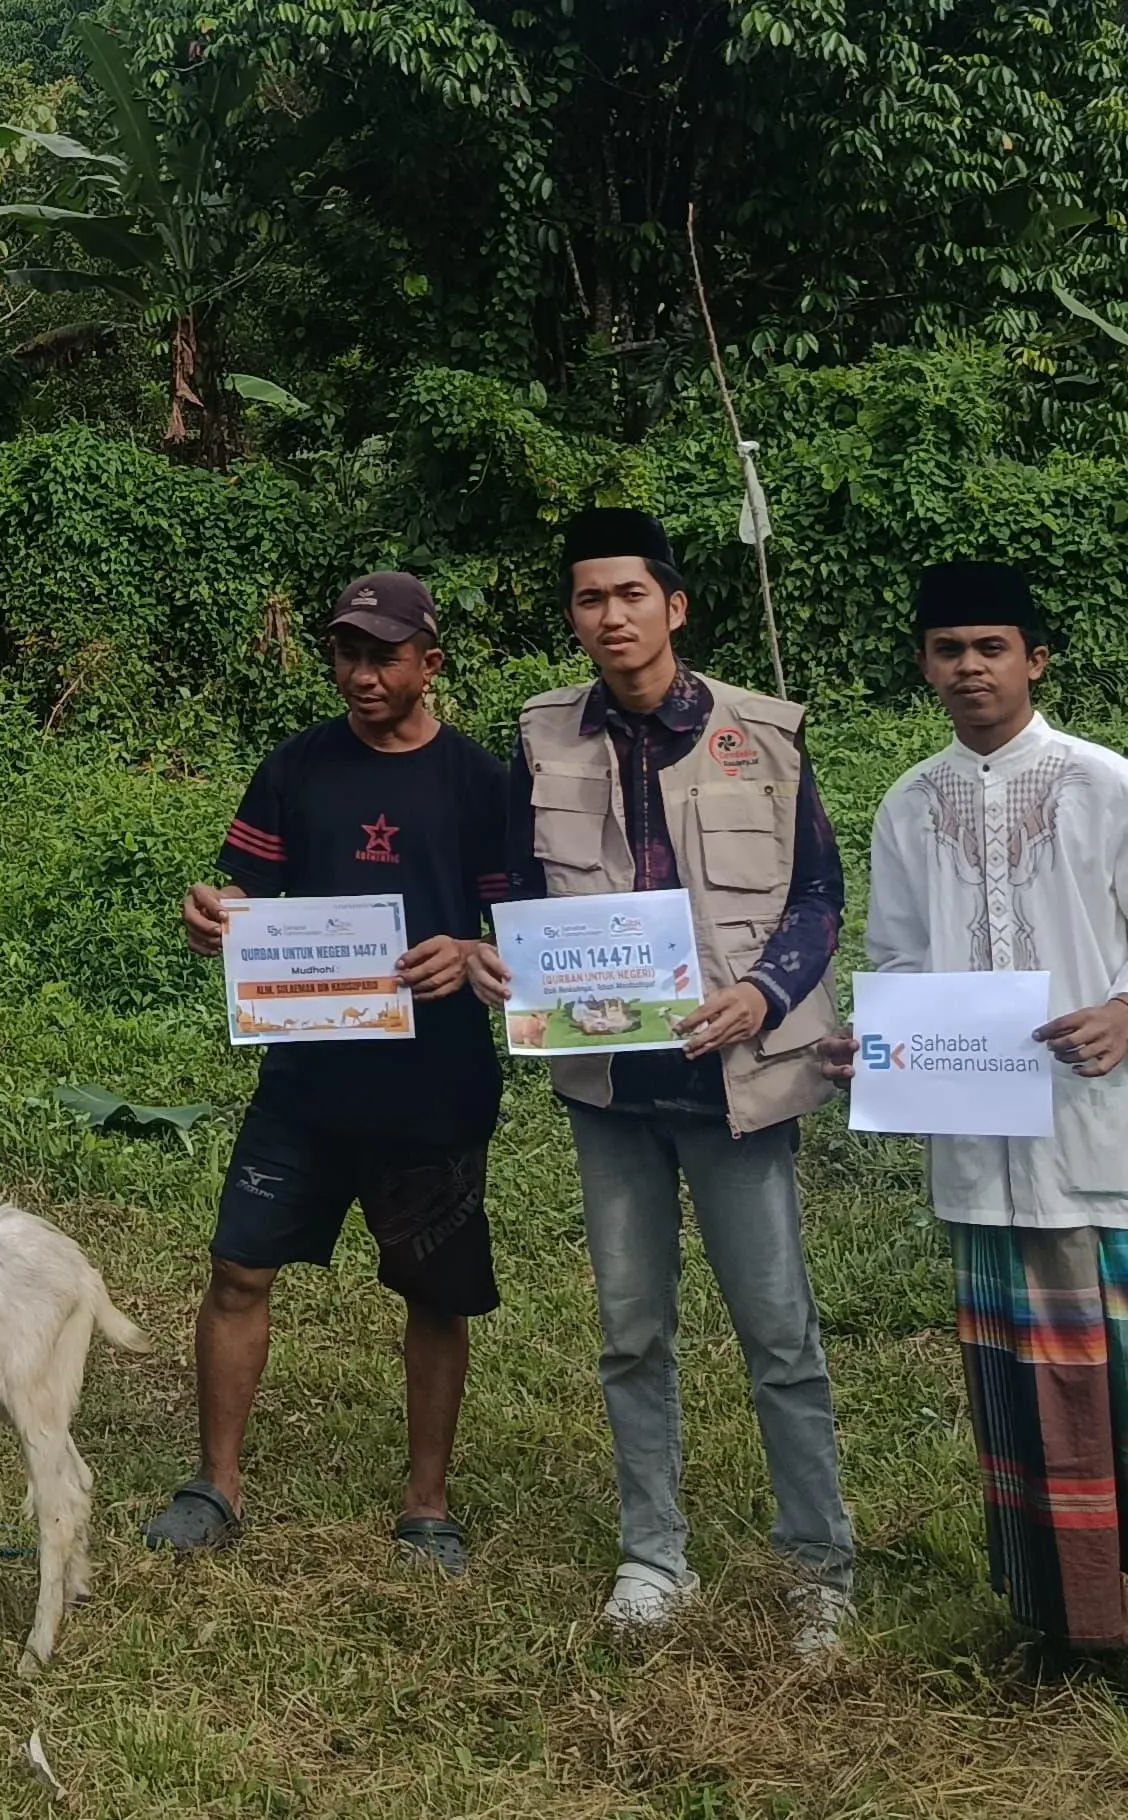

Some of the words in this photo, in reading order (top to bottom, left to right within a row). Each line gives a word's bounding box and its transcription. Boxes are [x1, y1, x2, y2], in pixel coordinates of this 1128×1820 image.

[241, 948, 280, 961] QURBAN
[282, 946, 314, 960] UNTUK
[317, 945, 350, 959] NEGERI
[353, 944, 377, 956] 1447
[380, 943, 388, 956] H
[540, 949, 582, 971] QUN
[587, 945, 632, 968] 1447
[637, 944, 652, 965] H
[291, 965, 335, 975] Mudhohi
[543, 973, 584, 985] (QURBAN
[585, 971, 616, 981] UNTUK
[617, 967, 655, 979] NEGERI)
[911, 1034, 988, 1052] Sahabat
[910, 1053, 1039, 1072] Kemanusiaan
